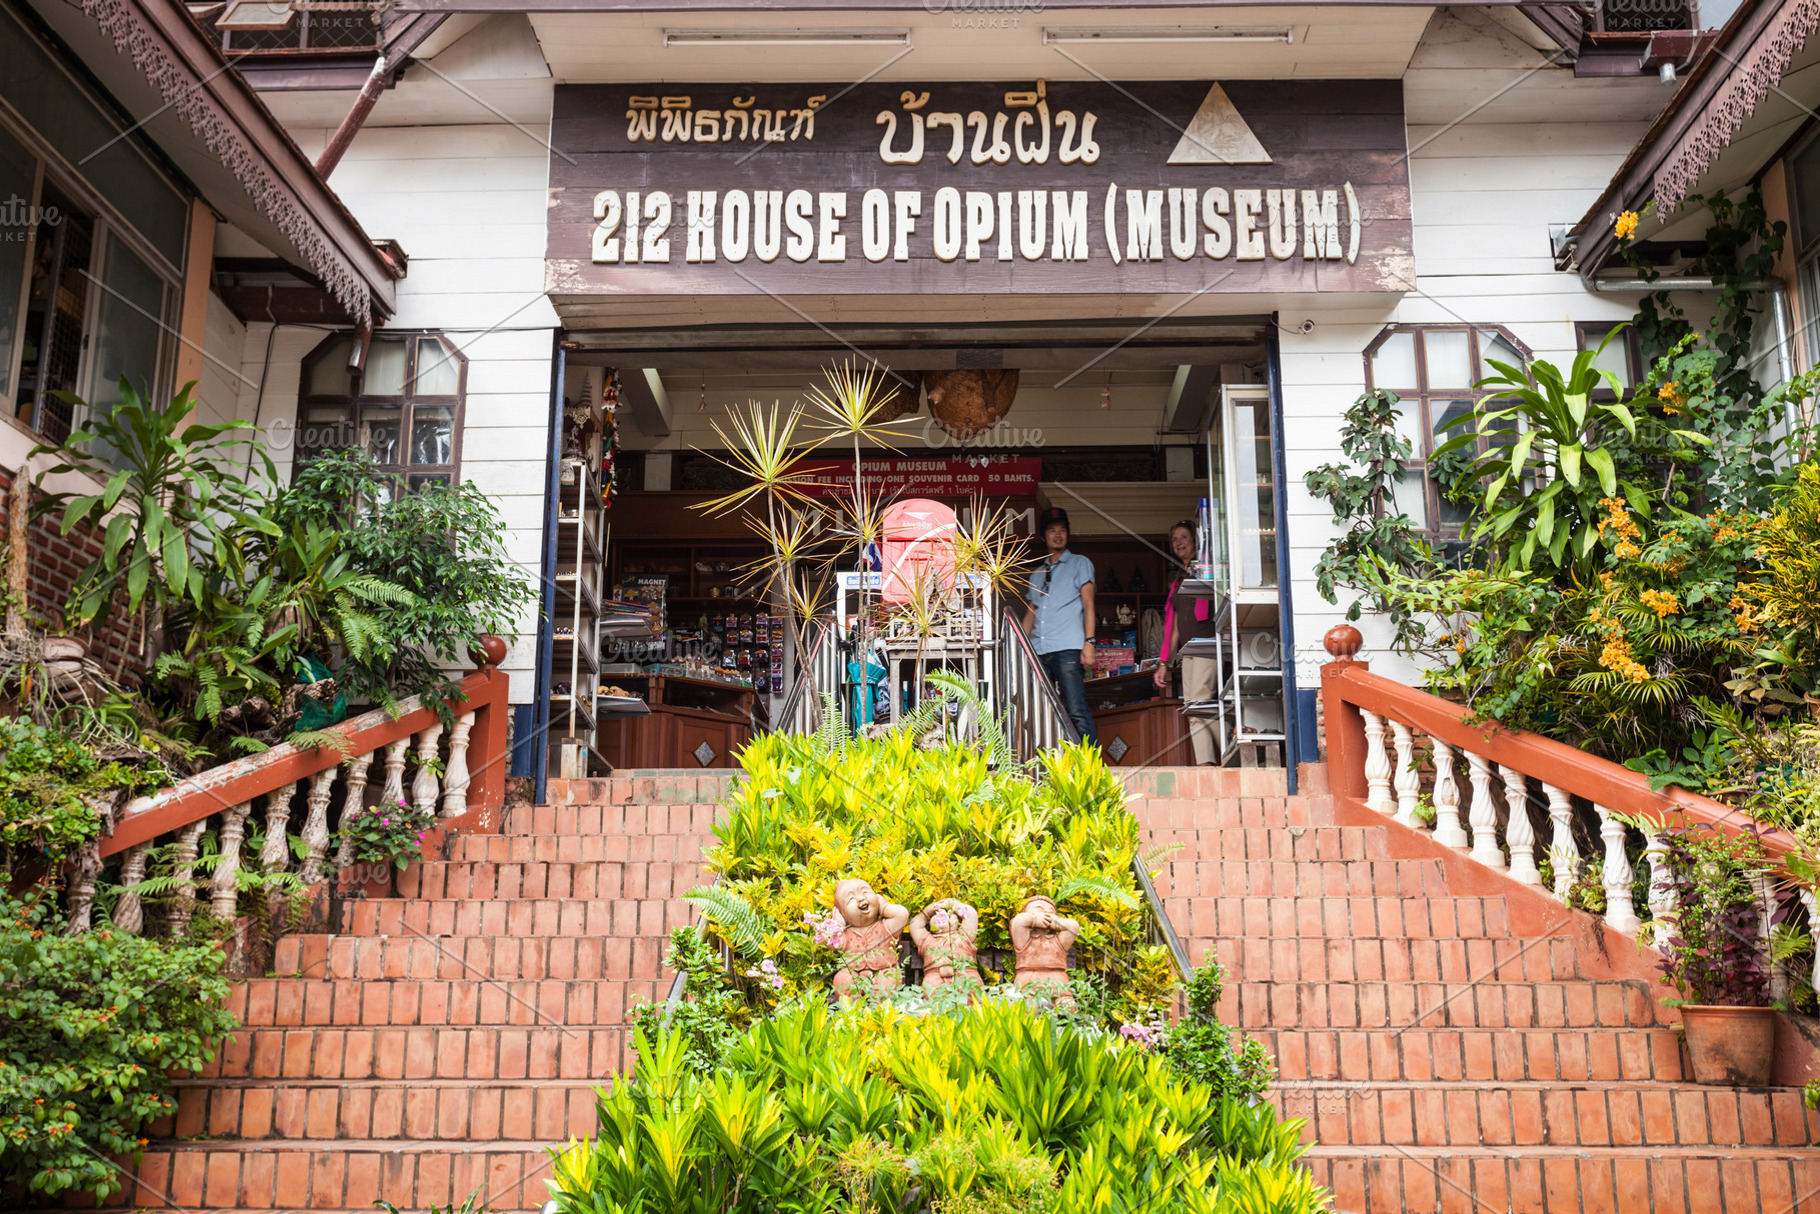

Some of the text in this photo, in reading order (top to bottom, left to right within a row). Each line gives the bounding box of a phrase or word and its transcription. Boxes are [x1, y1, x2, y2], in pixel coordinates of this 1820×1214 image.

[626, 79, 1101, 166] พิพิธภัณฑ์ บ้านฝิ่น
[590, 181, 1360, 266] 212 HOUSE OF OPIUM (MUSEUM)
[852, 461, 947, 472] OPIUM MUSEUM
[818, 475, 832, 483] FEE
[836, 475, 885, 483] INCLDING
[887, 475, 905, 483] ONE
[909, 474, 953, 483] SOUVENIR
[957, 474, 980, 482] CARD
[988, 474, 1001, 482] 50
[1004, 474, 1035, 482] BAHTS.
[791, 508, 1036, 536] MUUM
[638, 578, 666, 586] MAGNET
